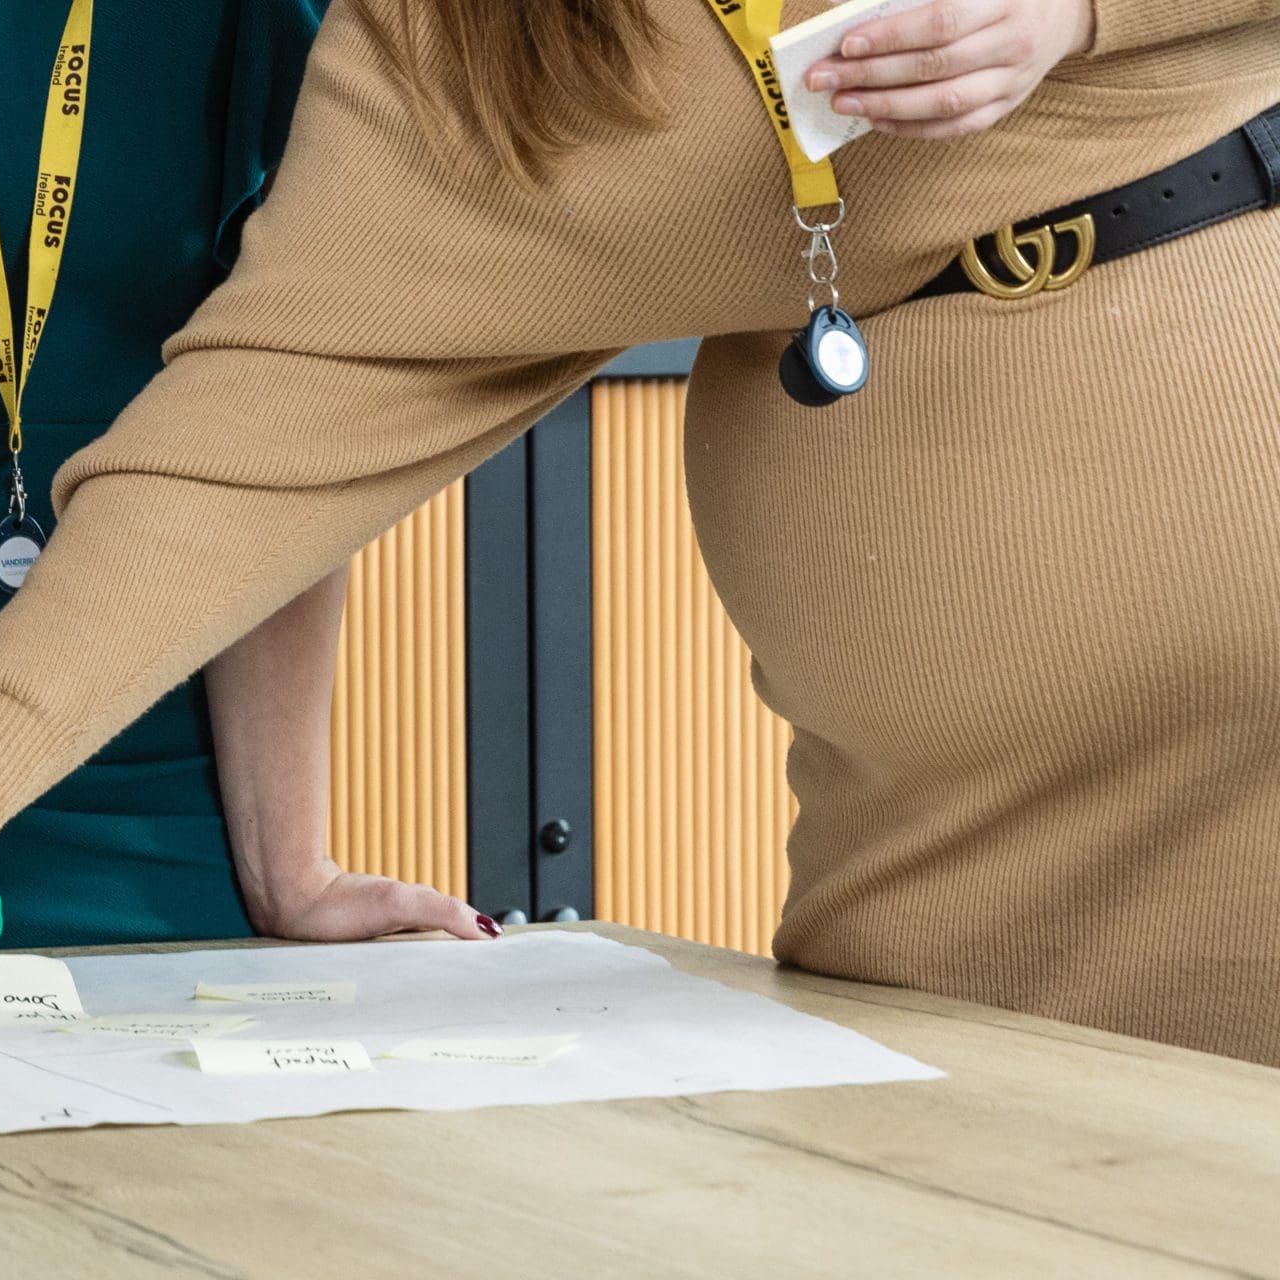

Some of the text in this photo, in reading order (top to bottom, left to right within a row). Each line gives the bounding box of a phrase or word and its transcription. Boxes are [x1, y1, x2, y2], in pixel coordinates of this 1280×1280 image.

[52, 45, 69, 86] Ireland
[62, 44, 85, 116] FOCUS
[35, 172, 51, 216] Ireland
[45, 175, 71, 249] FOCUS
[1, 338, 13, 382] Ireland
[269, 1052, 350, 1070] Impact
